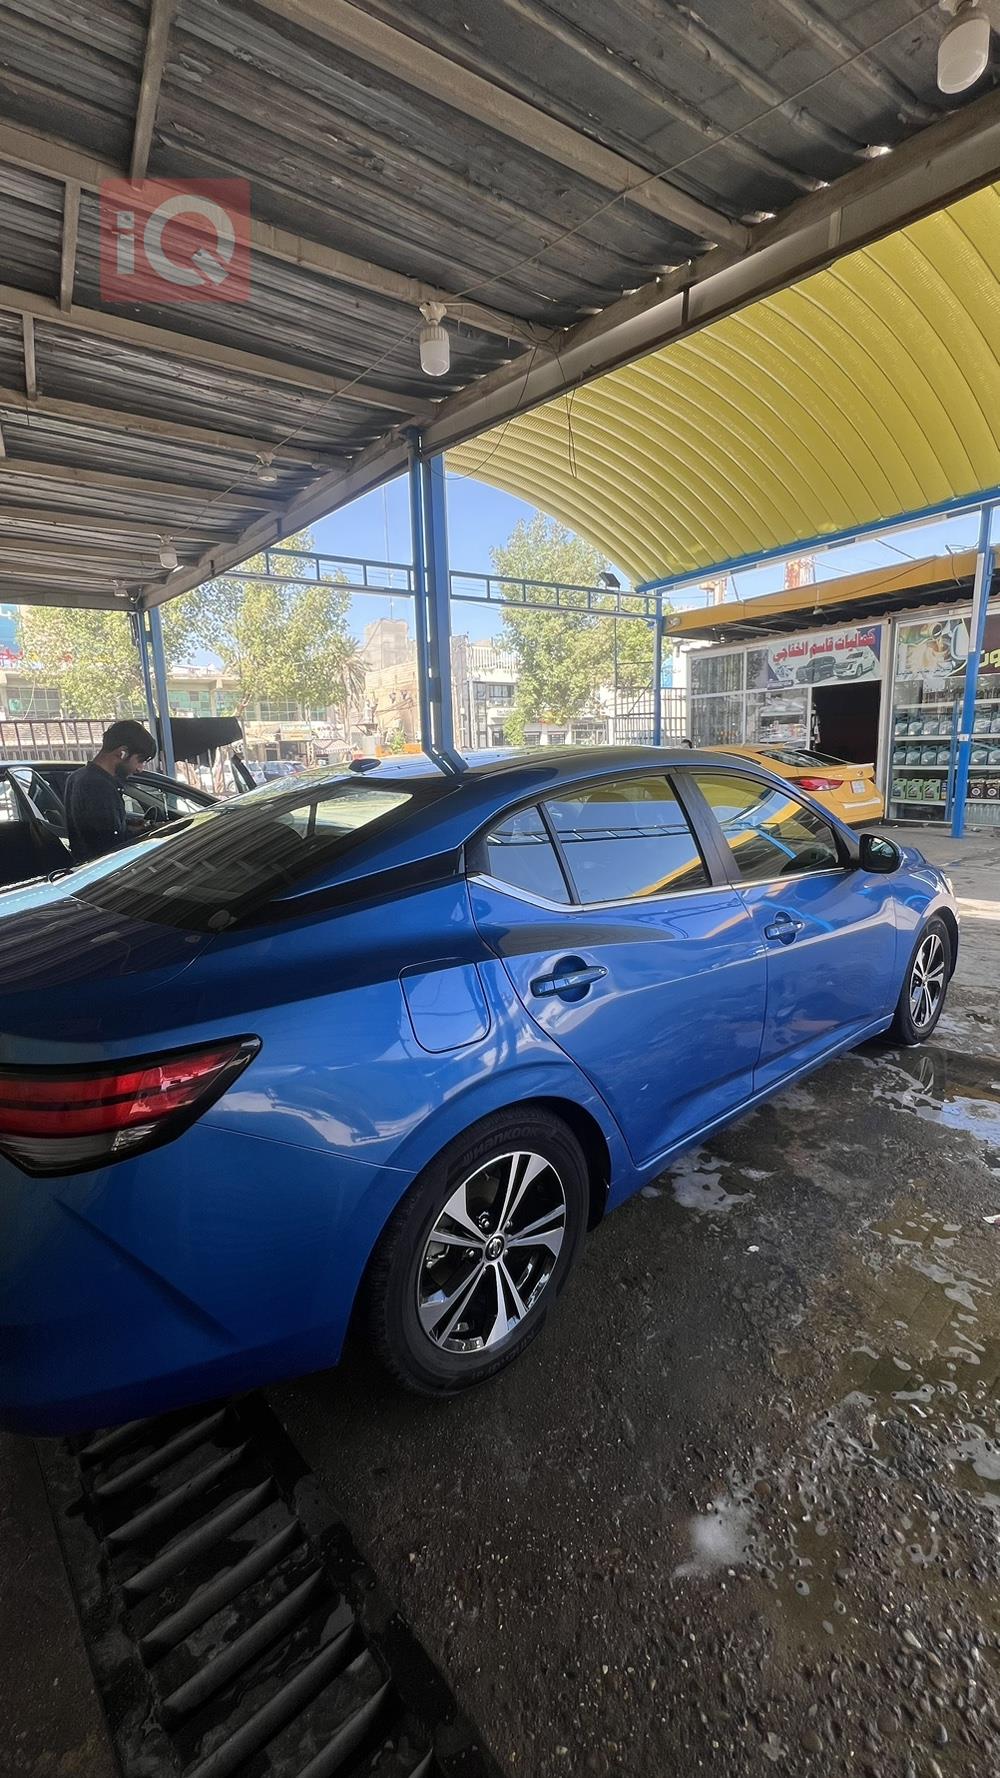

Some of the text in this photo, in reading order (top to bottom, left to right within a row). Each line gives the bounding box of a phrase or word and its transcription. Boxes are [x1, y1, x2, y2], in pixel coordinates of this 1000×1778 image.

[773, 629, 876, 663] كماليات قاسم الخفاجي
